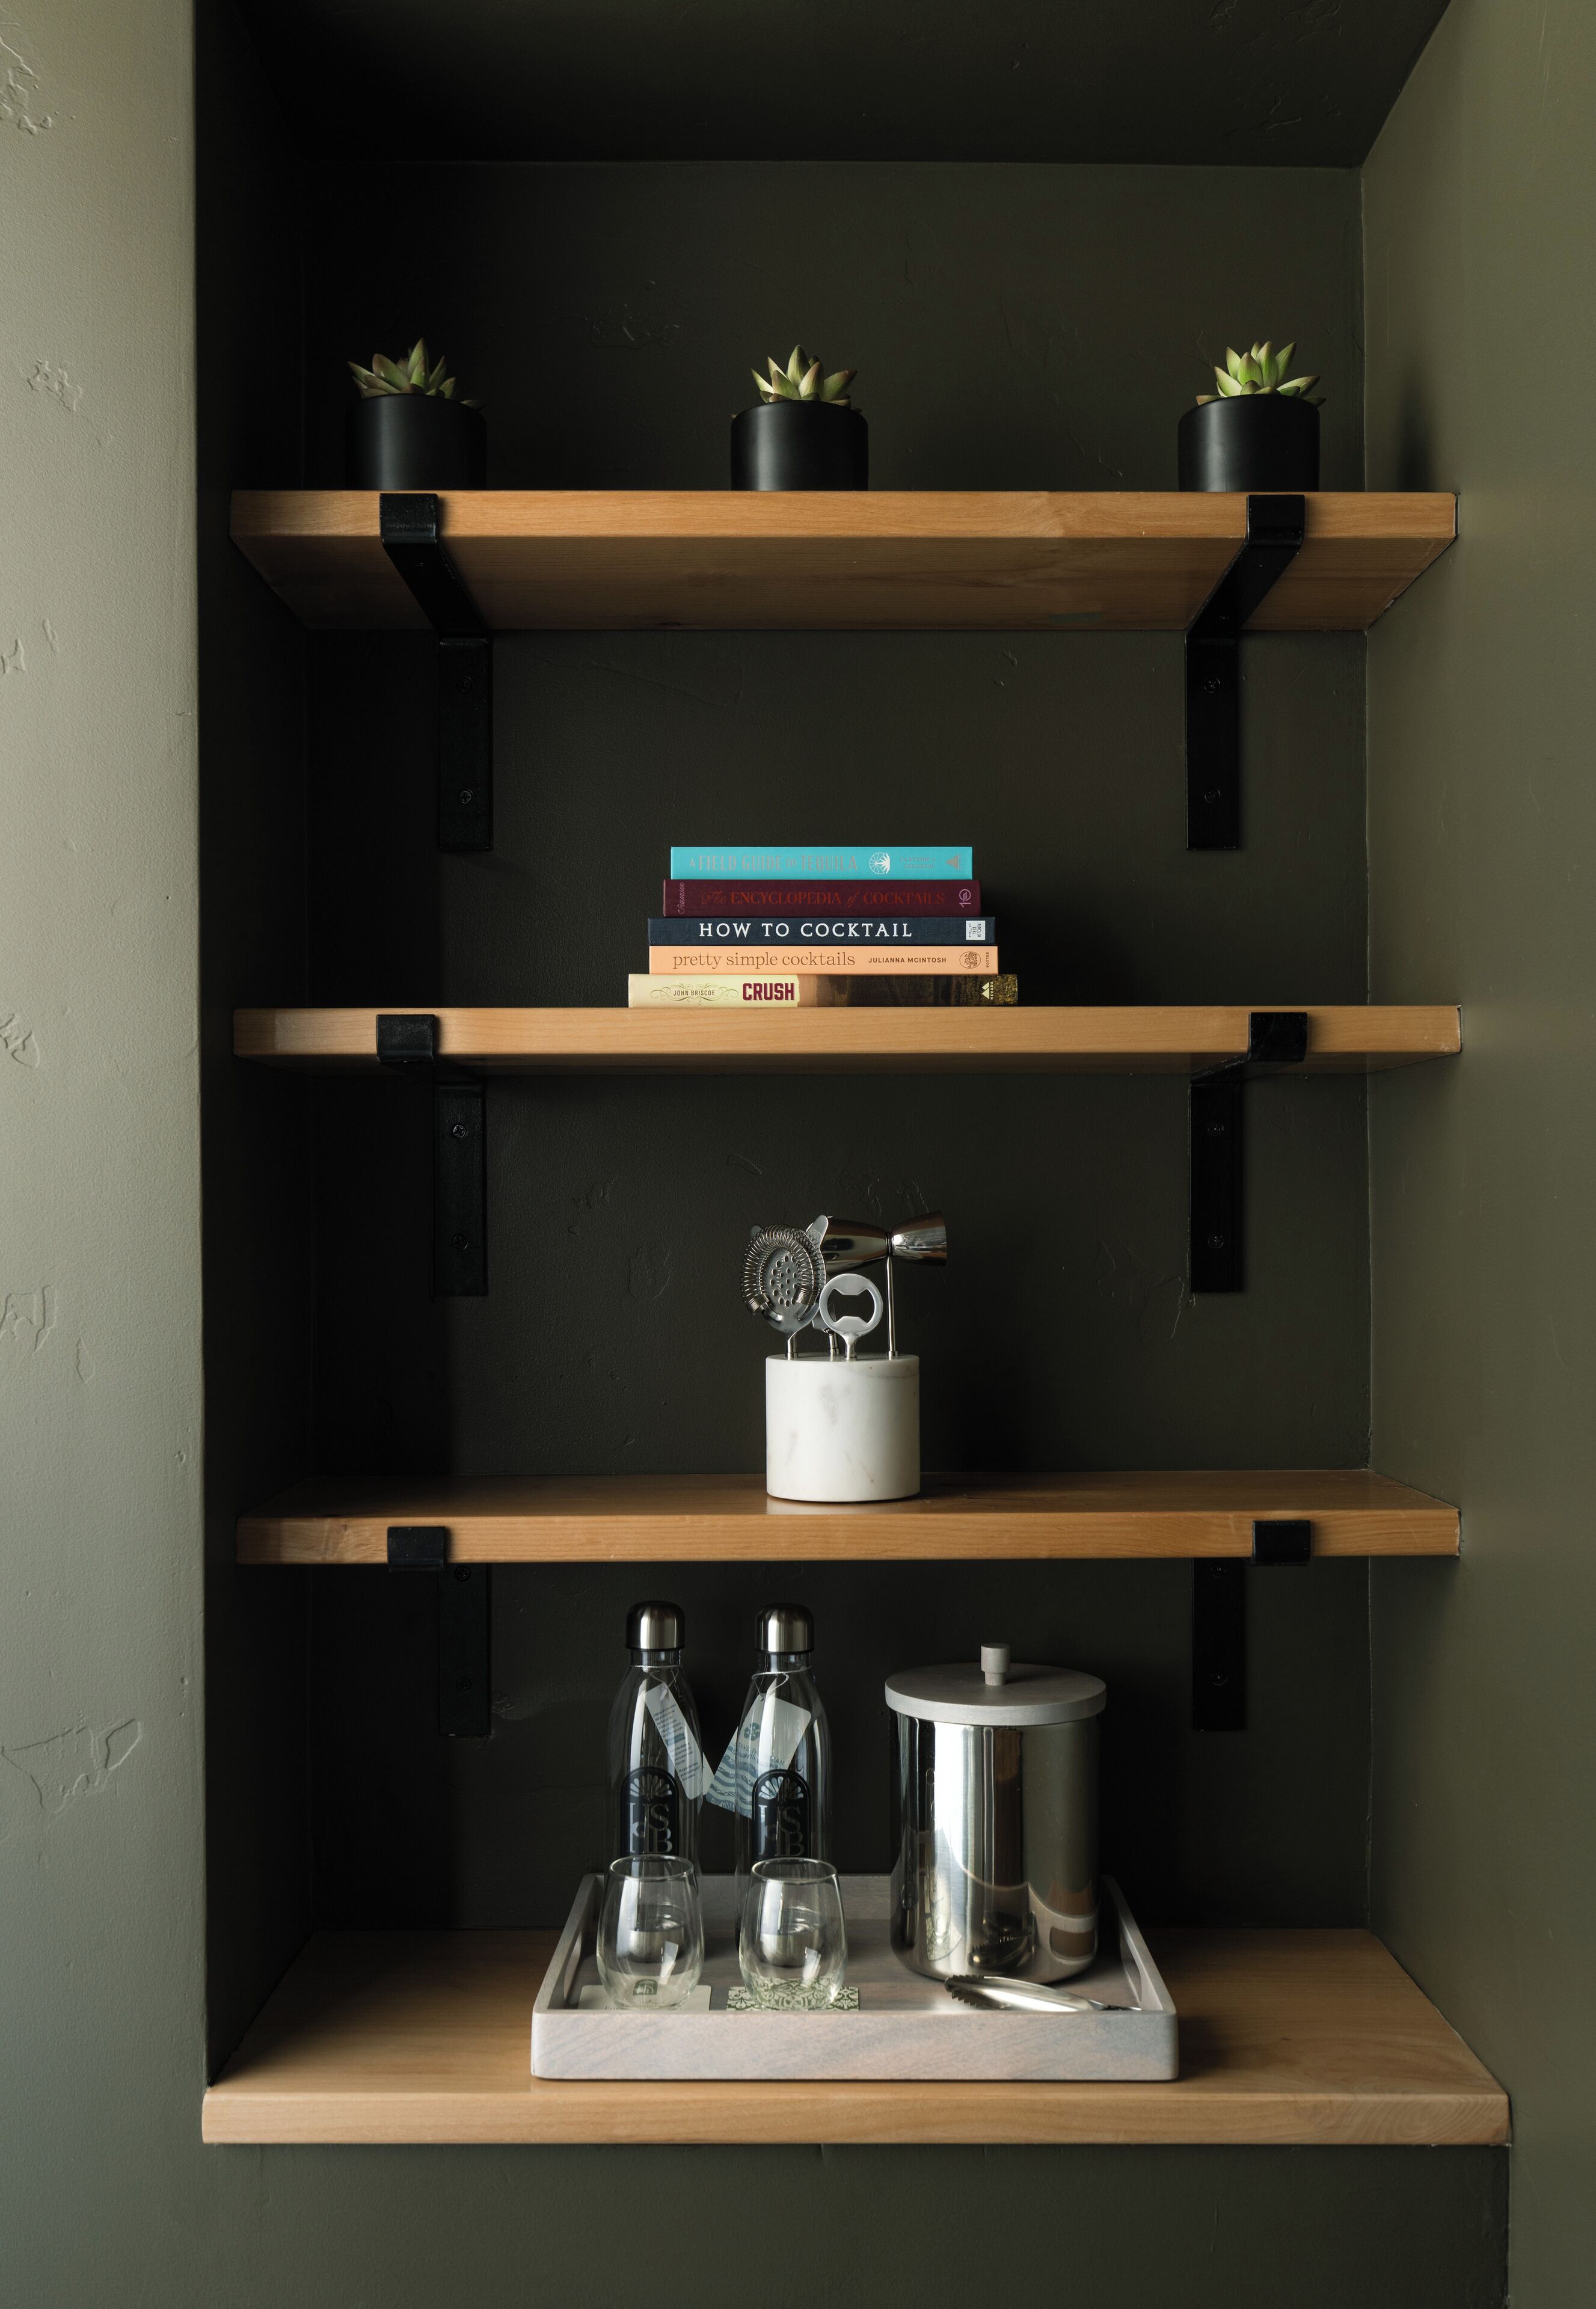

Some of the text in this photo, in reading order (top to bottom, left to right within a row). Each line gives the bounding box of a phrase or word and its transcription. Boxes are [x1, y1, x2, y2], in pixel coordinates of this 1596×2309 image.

[689, 857, 695, 867] A
[698, 856, 737, 871] FIELD
[741, 856, 782, 871] GUIDE
[800, 855, 858, 872] TEQUILA
[701, 891, 944, 907] The ENCYCLOPEDIA of COCKTAILS
[699, 922, 912, 937] HOW TO COCKTAIL
[673, 951, 855, 969] pretty simple cocktails
[742, 983, 794, 1001] CRUSH
